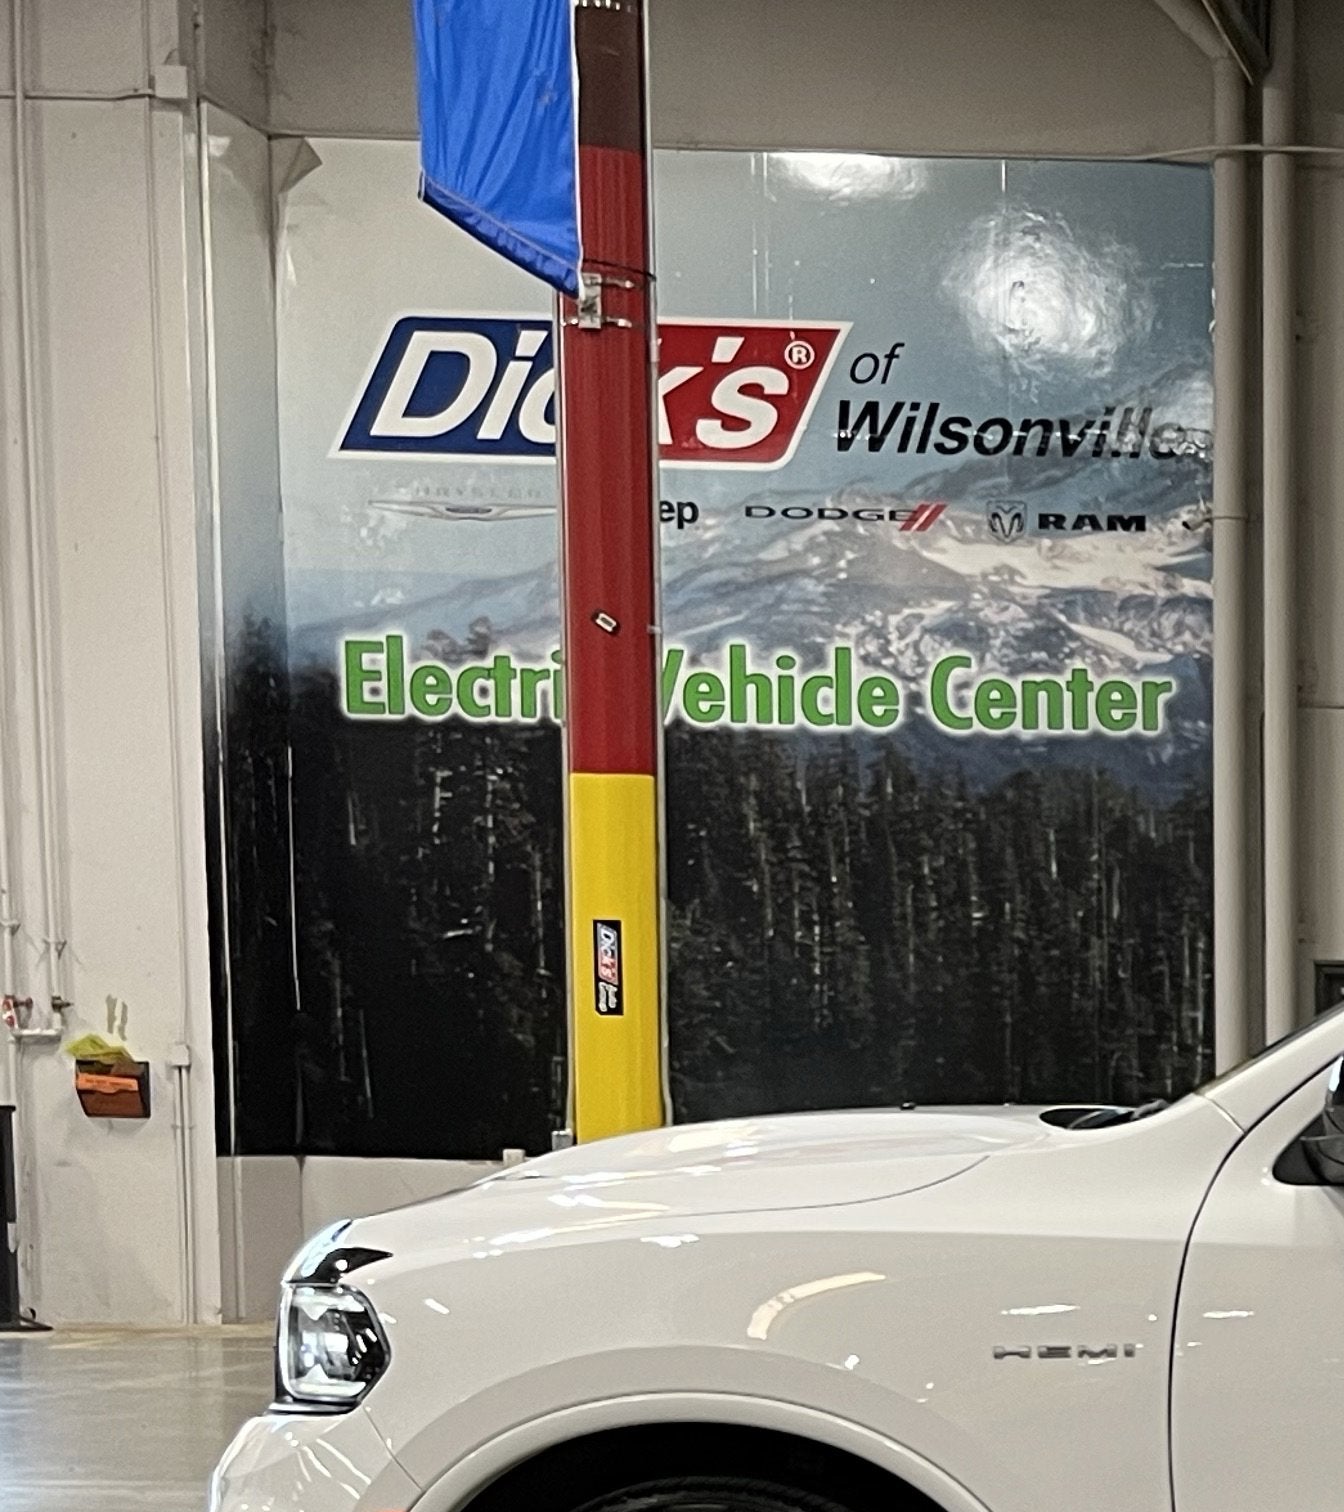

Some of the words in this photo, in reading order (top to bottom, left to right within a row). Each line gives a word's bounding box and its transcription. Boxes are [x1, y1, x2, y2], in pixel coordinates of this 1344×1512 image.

[849, 342, 905, 385] of
[659, 500, 699, 530] ep
[744, 505, 918, 523] DODGE
[1037, 513, 1147, 532] RAM
[345, 634, 563, 719] Electri
[930, 656, 1173, 731] Center
[993, 1343, 1136, 1359] HEMI
